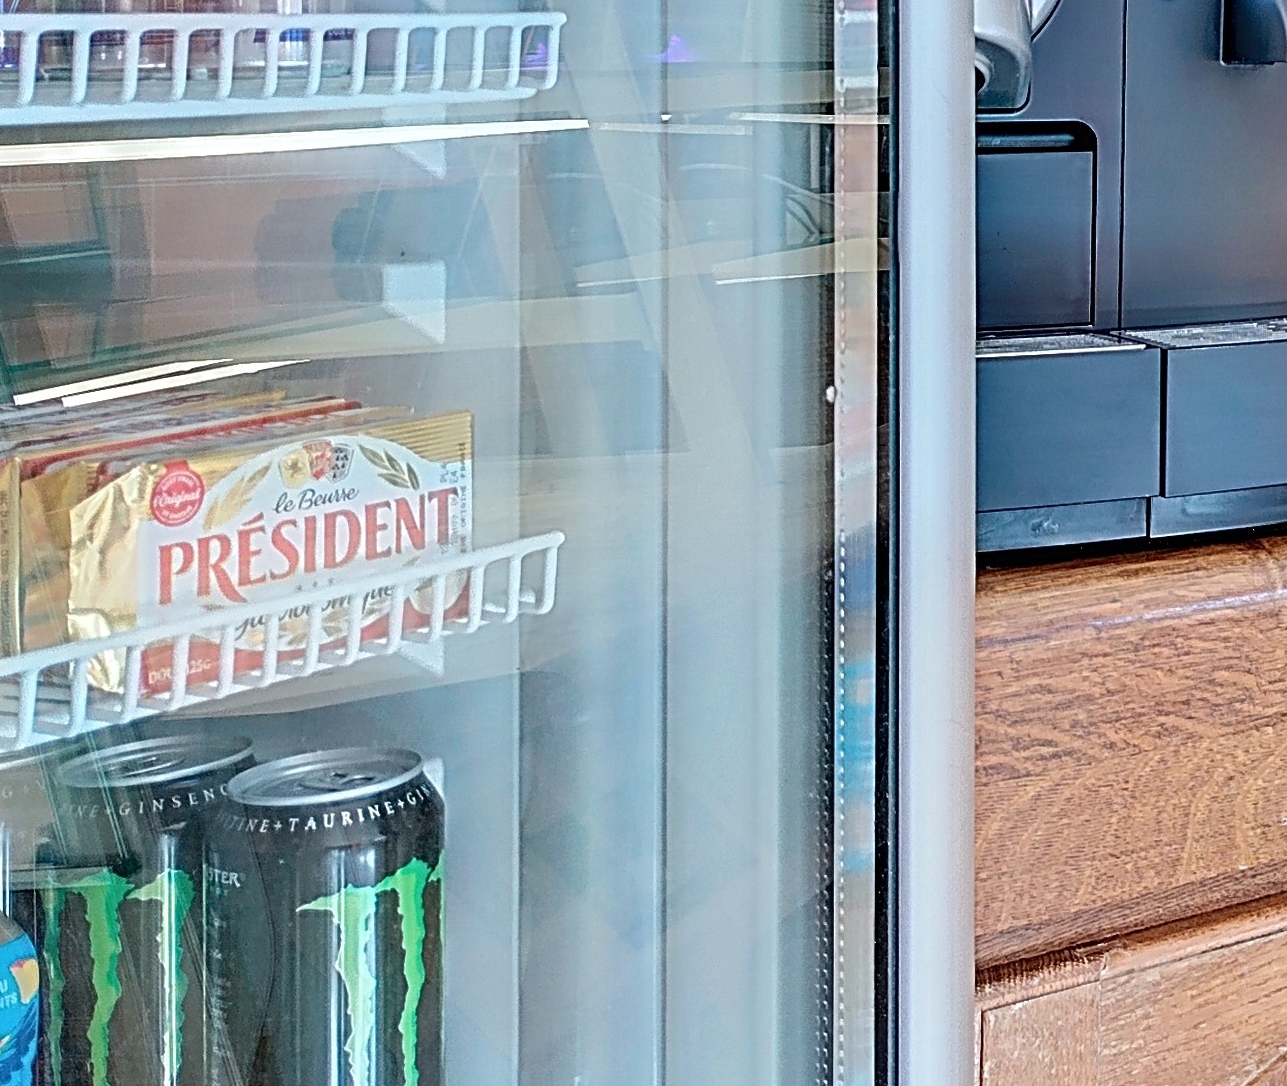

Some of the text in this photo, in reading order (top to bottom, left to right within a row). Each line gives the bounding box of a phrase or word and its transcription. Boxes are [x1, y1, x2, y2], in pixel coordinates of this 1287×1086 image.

[272, 486, 360, 514] le Beurre
[158, 486, 459, 605] PRÉSIDENT
